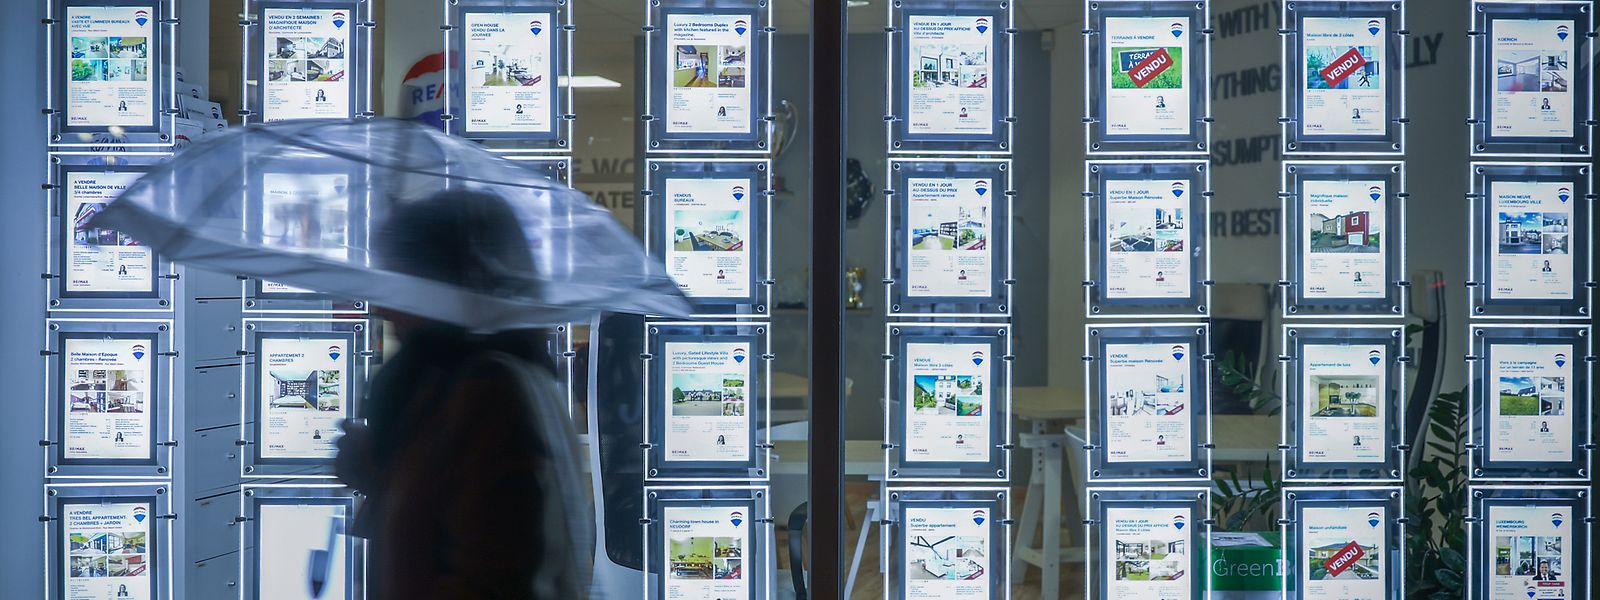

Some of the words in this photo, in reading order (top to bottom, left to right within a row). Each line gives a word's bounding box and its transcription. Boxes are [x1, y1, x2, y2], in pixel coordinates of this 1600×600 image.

[1218, 10, 1269, 40] WITH
[1134, 54, 1167, 81] VENDU
[1327, 54, 1360, 80] VENDU
[1231, 208, 1281, 237] BEST
[1329, 546, 1359, 571] VENDU
